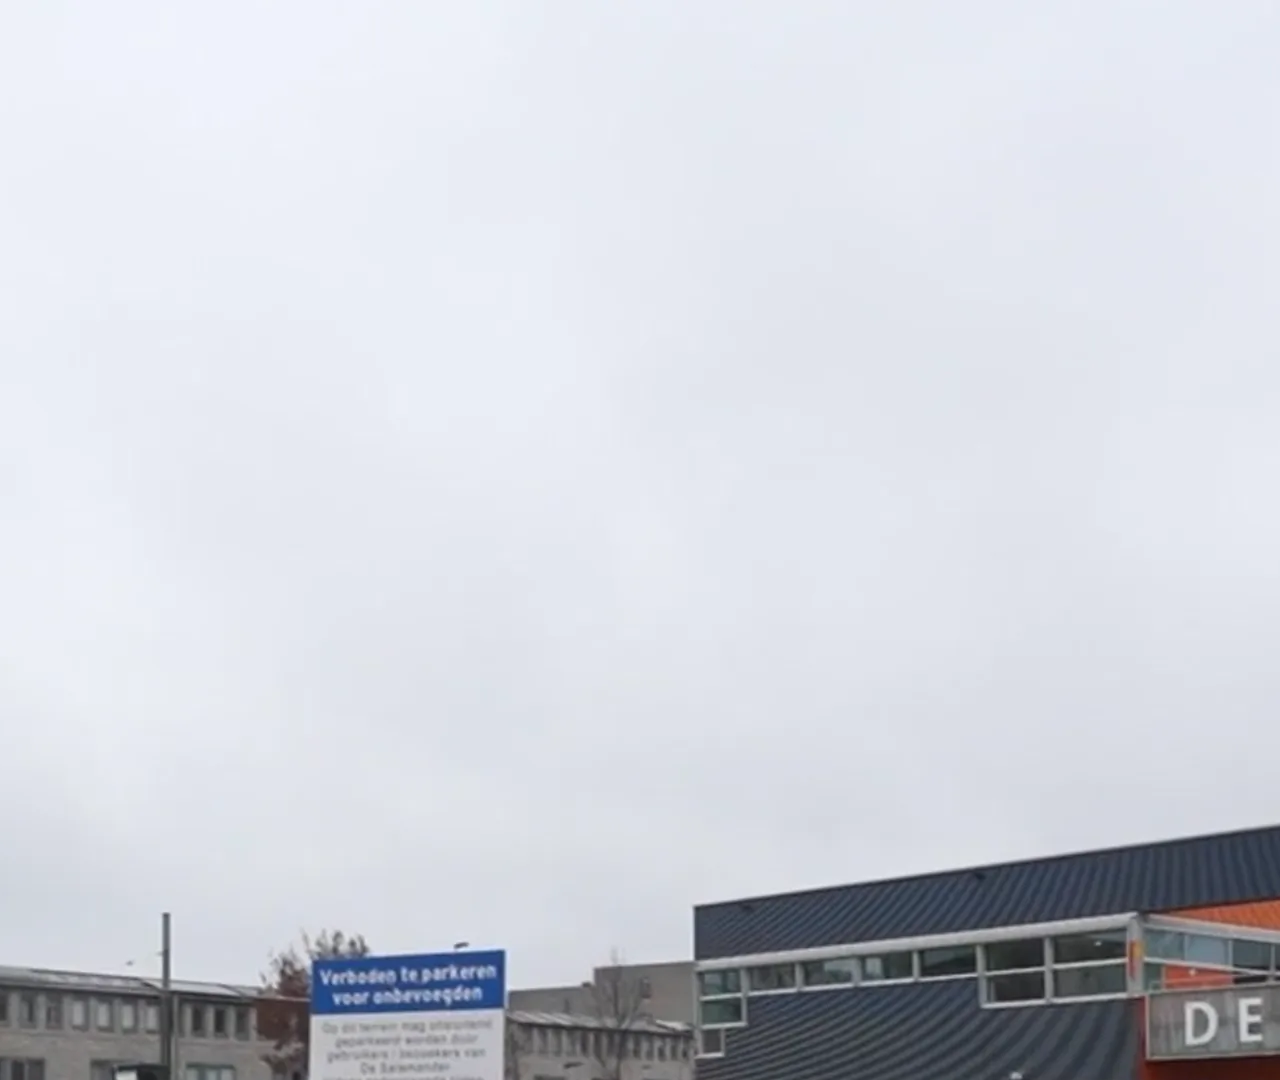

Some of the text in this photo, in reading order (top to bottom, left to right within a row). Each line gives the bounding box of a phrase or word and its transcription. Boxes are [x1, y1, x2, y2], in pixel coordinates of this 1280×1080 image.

[319, 964, 497, 986] Verboden te parkeren
[332, 985, 483, 1006] voor onbevoegden
[1184, 997, 1263, 1046] DE
